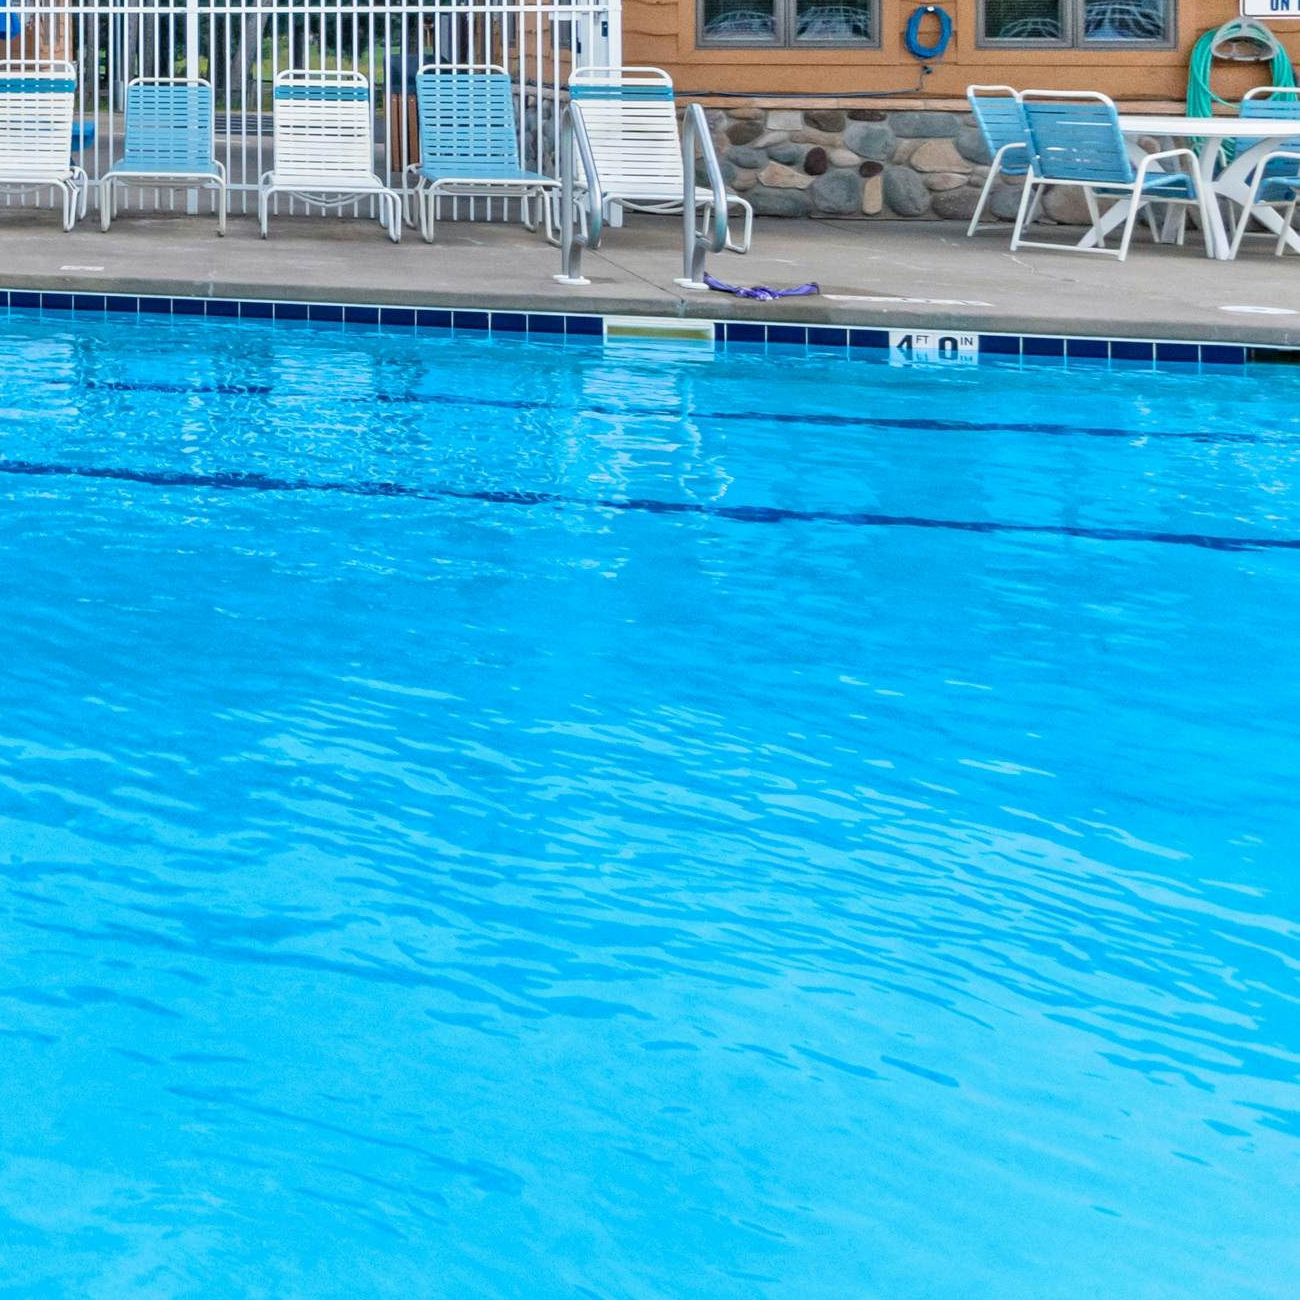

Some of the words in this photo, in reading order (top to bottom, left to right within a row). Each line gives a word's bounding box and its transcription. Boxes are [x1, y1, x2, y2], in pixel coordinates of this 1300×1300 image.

[916, 335, 929, 344] FT
[939, 336, 958, 356] 0
[960, 337, 973, 345] IN
